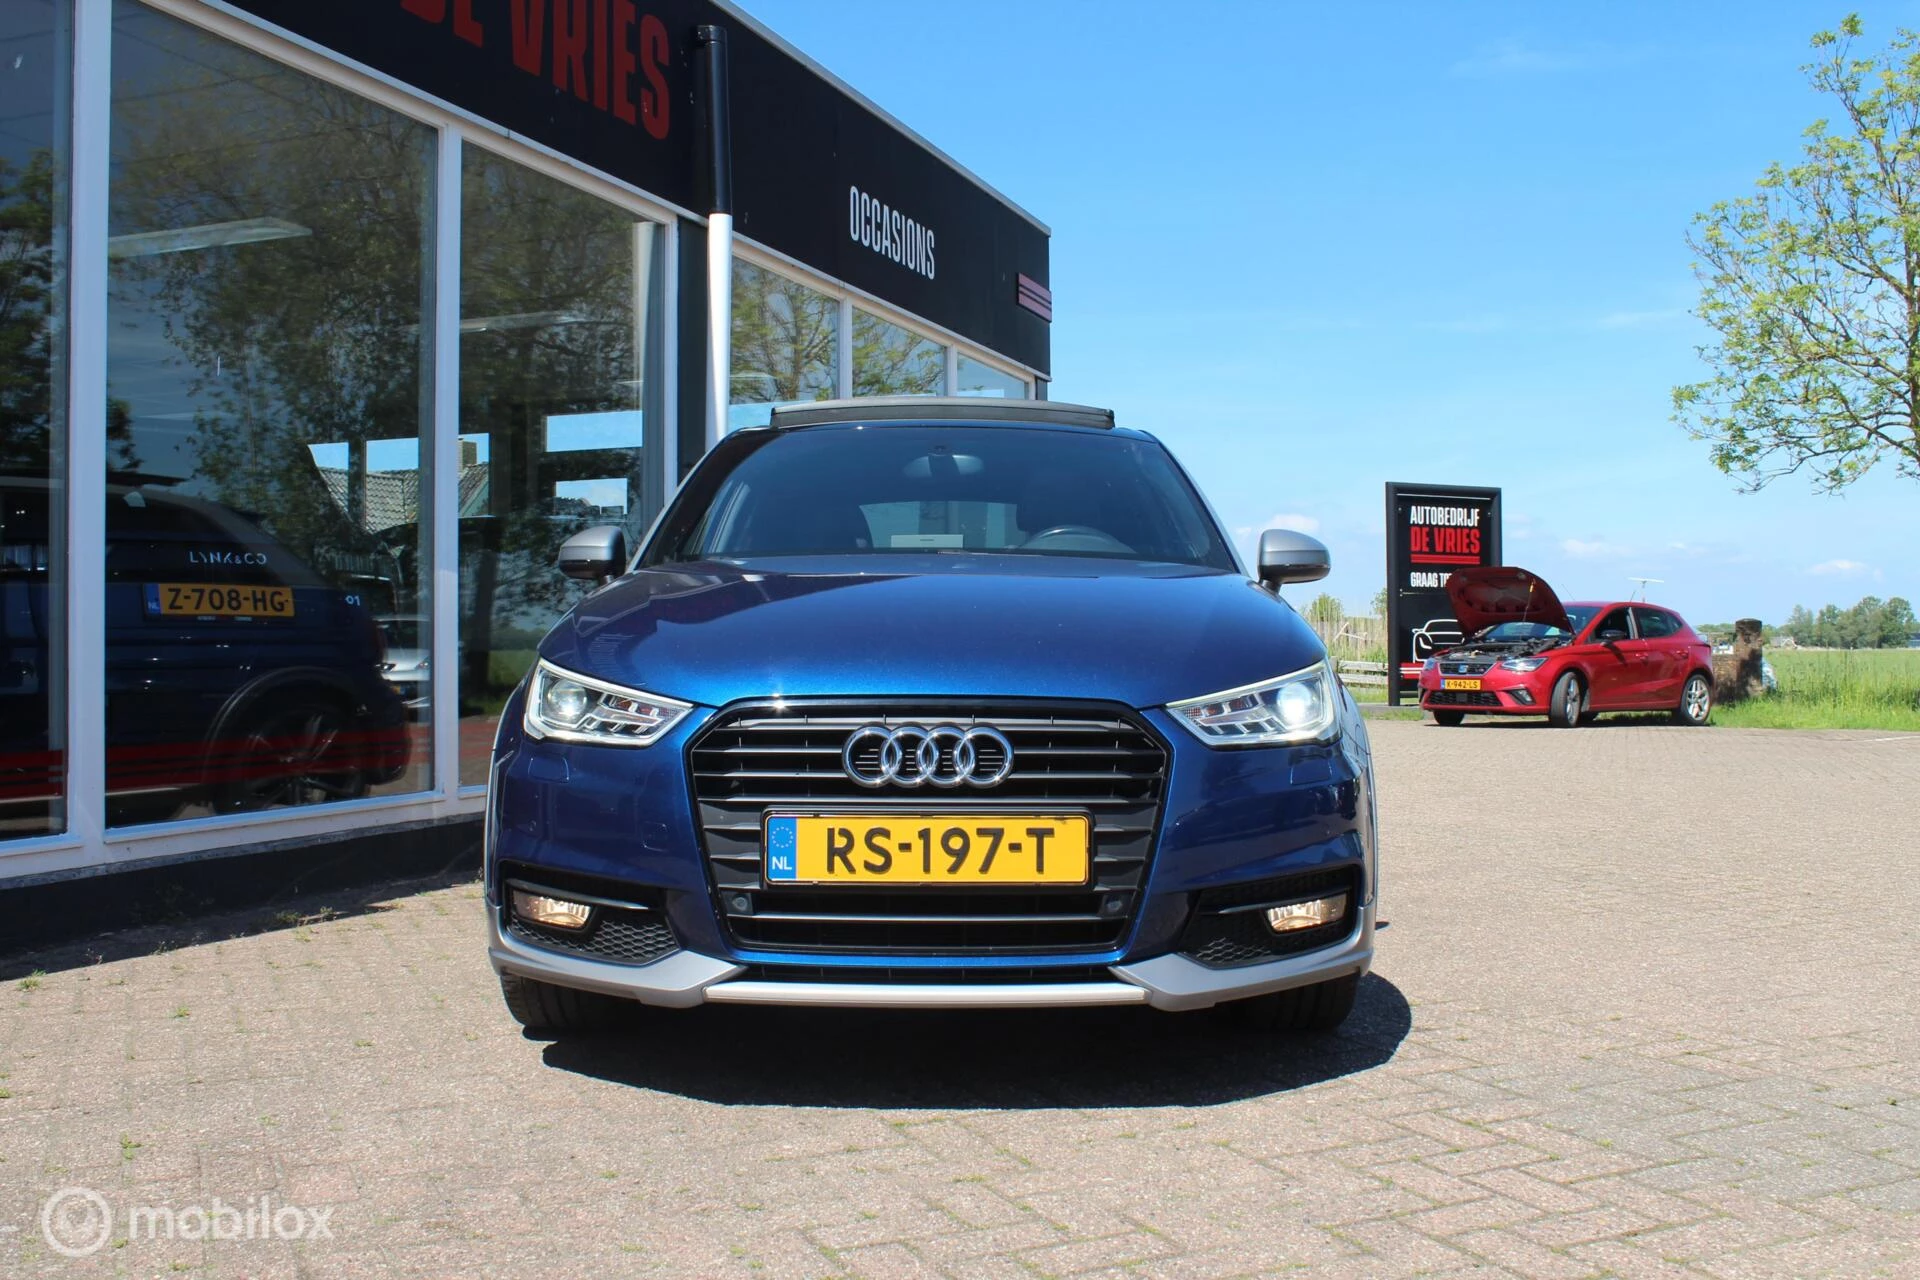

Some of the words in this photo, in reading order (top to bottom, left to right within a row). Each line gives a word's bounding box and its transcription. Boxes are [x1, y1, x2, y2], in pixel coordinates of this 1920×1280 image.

[849, 185, 935, 280] OCCASIONS
[1410, 505, 1480, 527] AUTOBEDRIJF
[1410, 526, 1430, 552] DE
[1434, 527, 1480, 554] VRIES
[1410, 571, 1438, 588] GRAAG
[167, 587, 288, 612] Z-708-HG
[772, 857, 793, 871] NL
[826, 827, 1055, 875] RS-197-T
